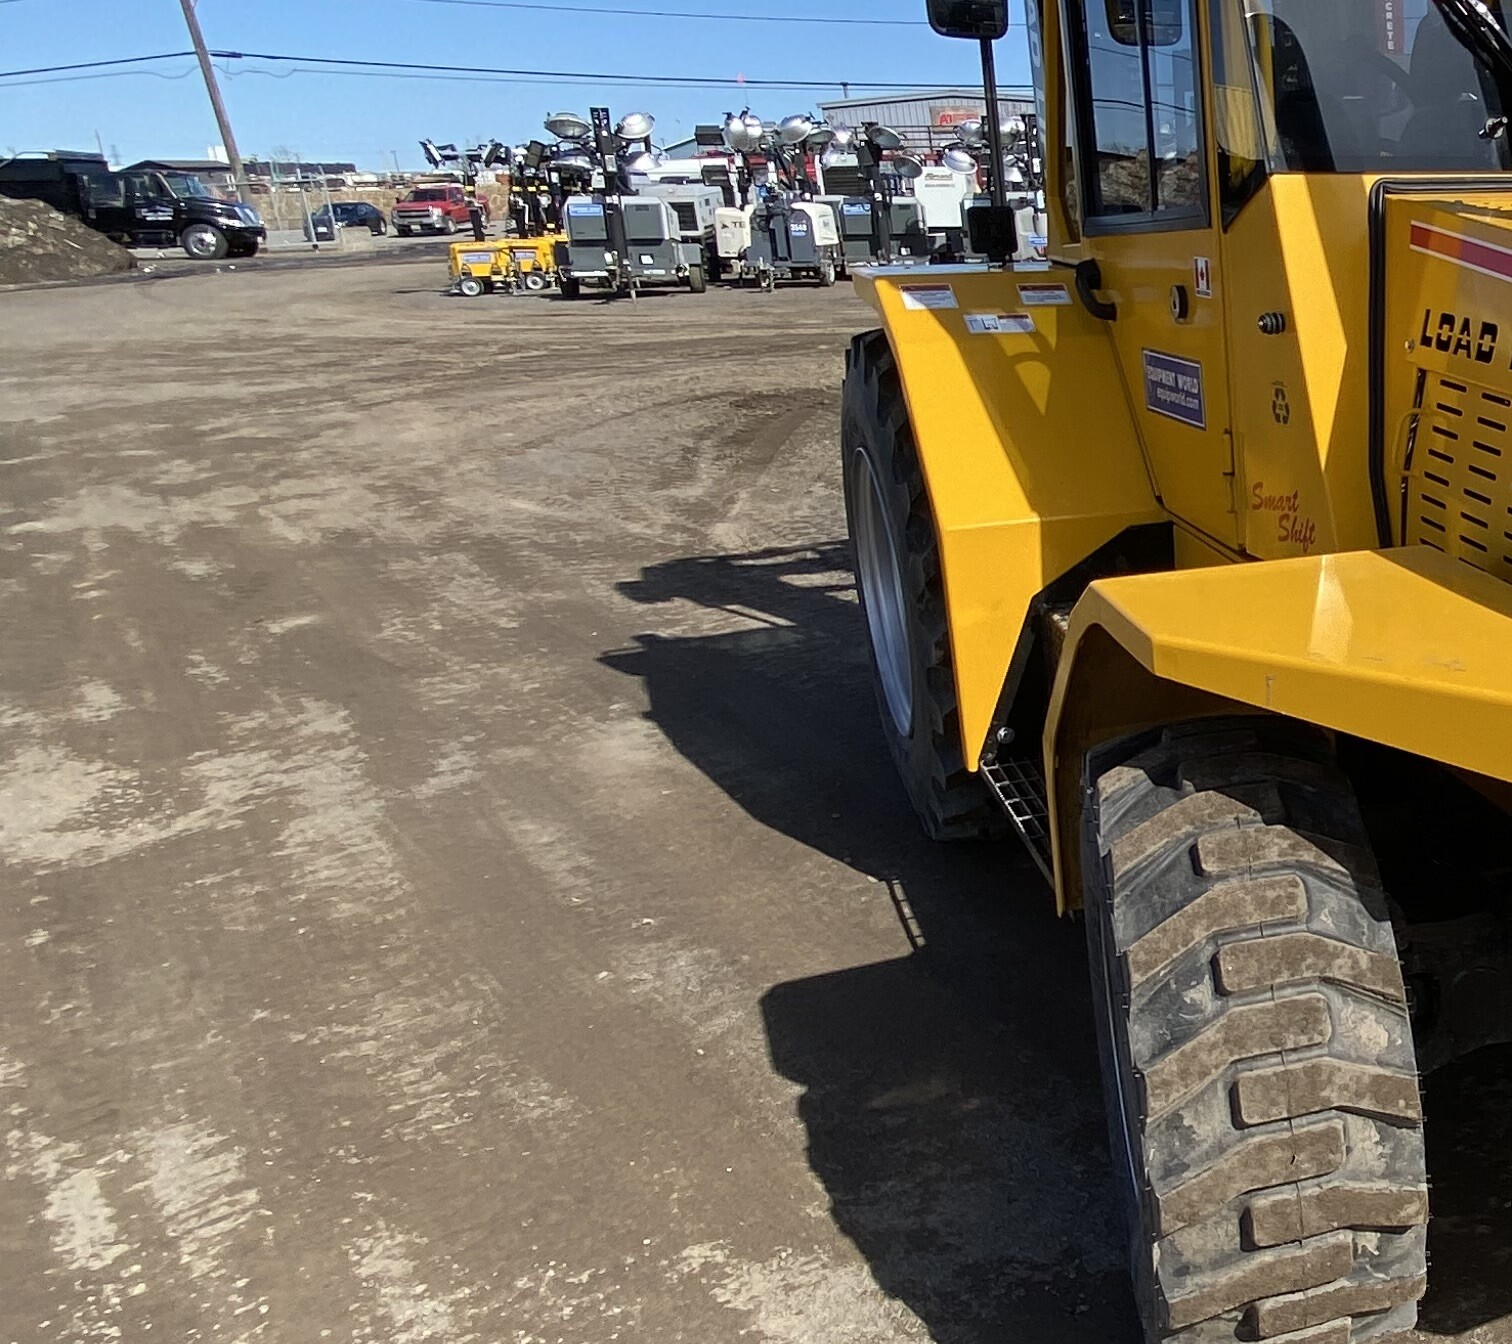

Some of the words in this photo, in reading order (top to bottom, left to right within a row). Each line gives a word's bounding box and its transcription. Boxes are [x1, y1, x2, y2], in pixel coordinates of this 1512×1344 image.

[1419, 308, 1498, 364] LOAD
[1251, 481, 1300, 512] Smart
[1277, 513, 1317, 554] Shift
